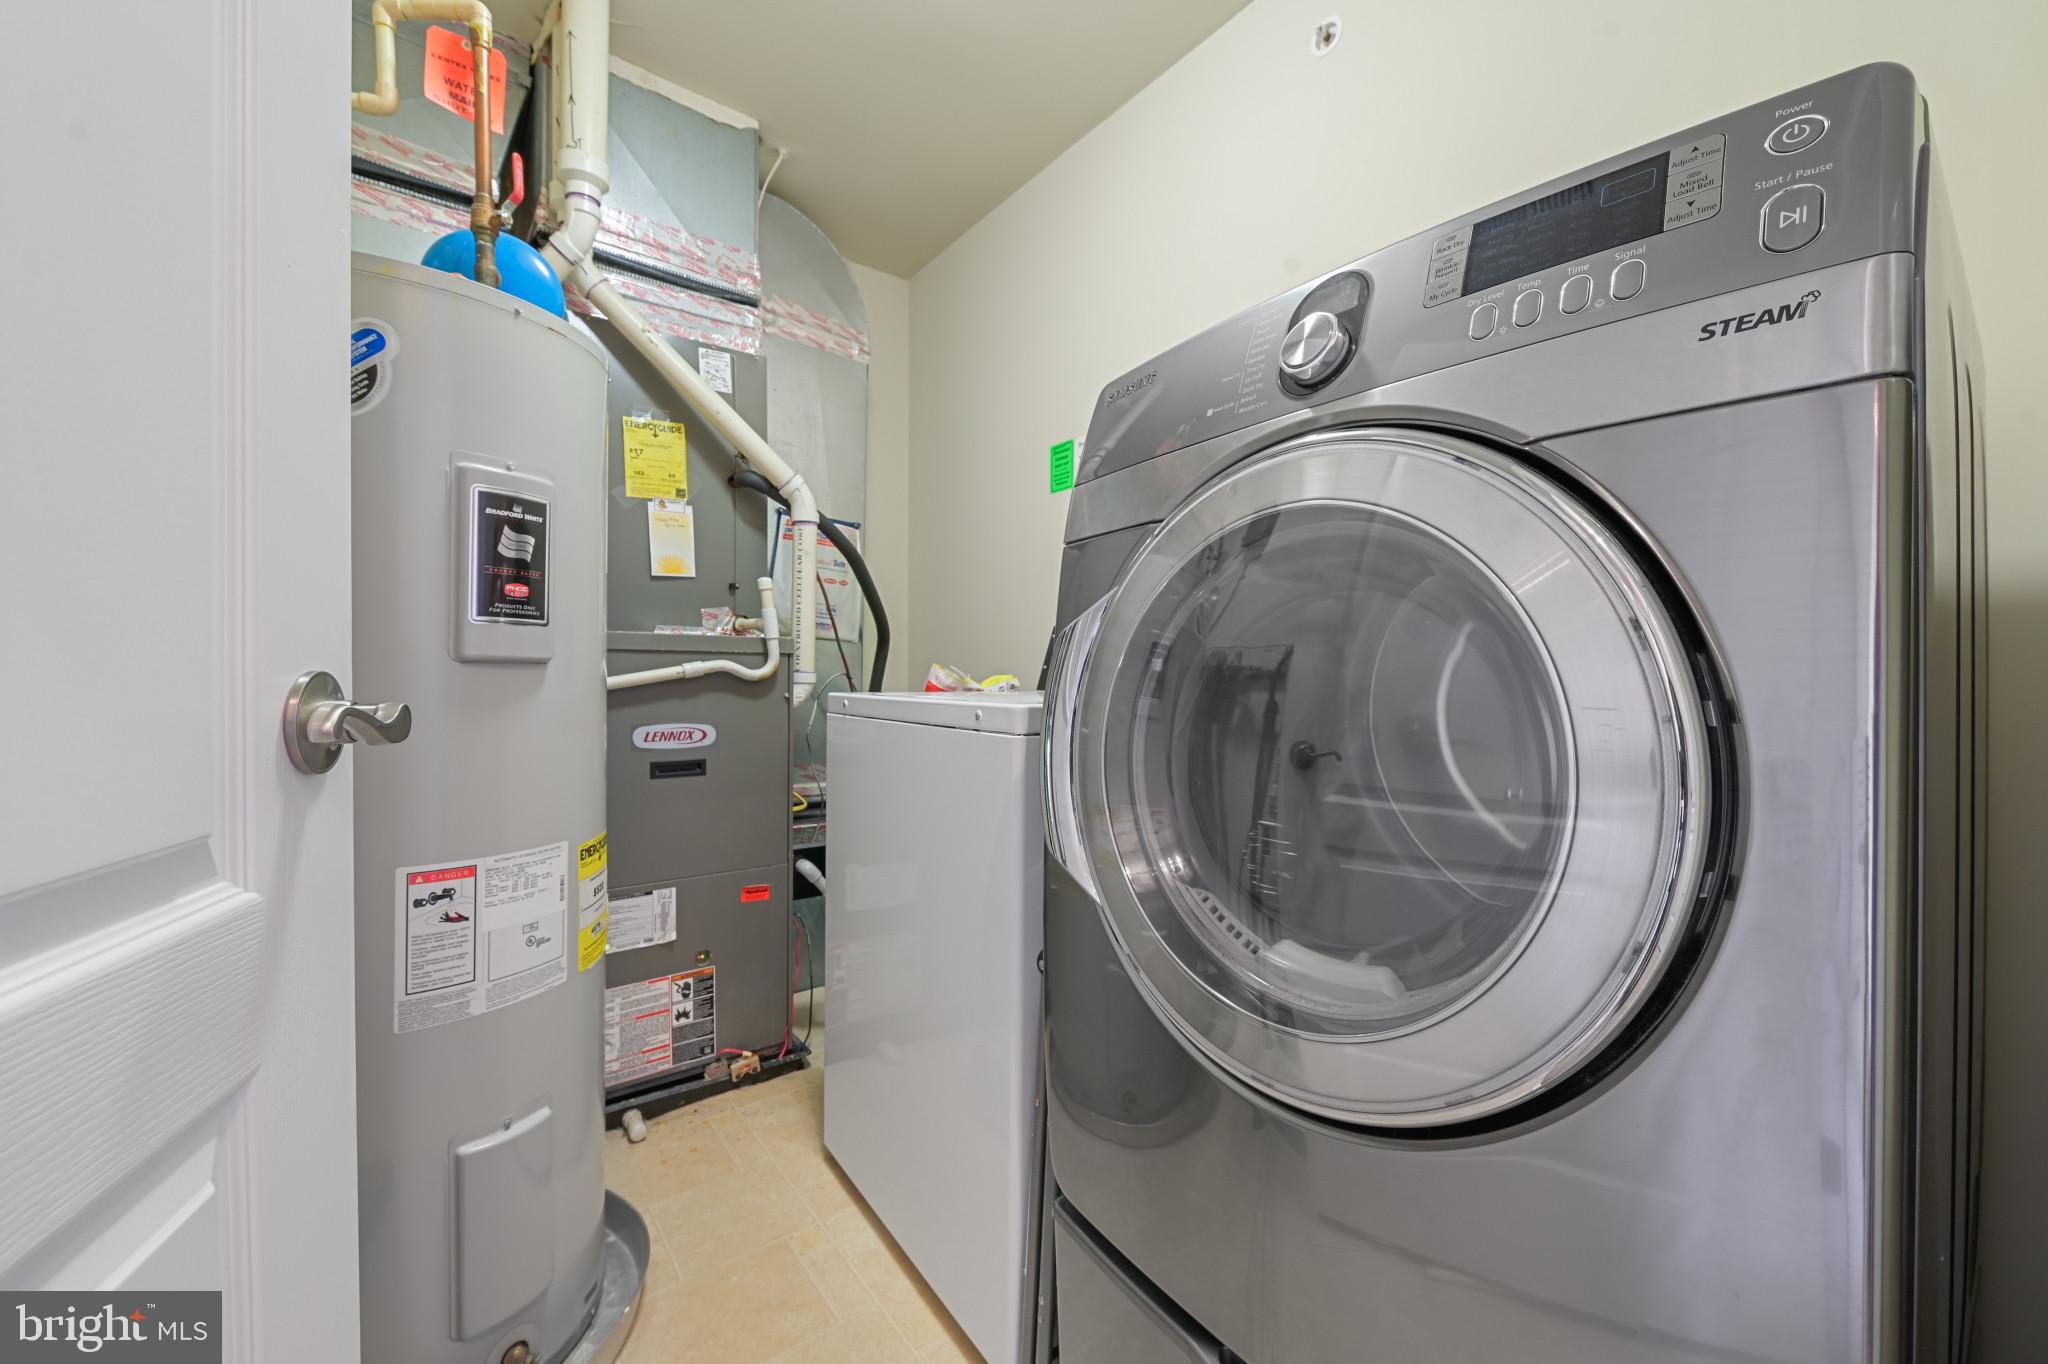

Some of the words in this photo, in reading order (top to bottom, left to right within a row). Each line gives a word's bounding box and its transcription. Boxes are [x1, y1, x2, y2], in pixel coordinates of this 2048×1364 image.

[443, 75, 476, 95] WATE
[1775, 100, 1814, 118] Power
[1671, 155, 1698, 168] Adjust
[1701, 147, 1721, 159] Time
[1680, 174, 1708, 189] Mixed
[1754, 174, 1784, 191] Start
[1795, 162, 1833, 179] Pause
[1673, 186, 1695, 198] Load
[1667, 211, 1694, 224] Adjust
[1697, 203, 1717, 214] Time
[1614, 244, 1646, 261] Signal
[1567, 263, 1590, 276] Time
[1517, 278, 1543, 291] Temp.
[1467, 298, 1482, 308] Dry
[1483, 289, 1505, 302] Level
[1698, 299, 1810, 342] STEAM
[485, 507, 524, 519] BRADFORD
[524, 513, 544, 523] WHITE
[643, 730, 695, 743] LENNOX
[430, 870, 470, 881] DANGER
